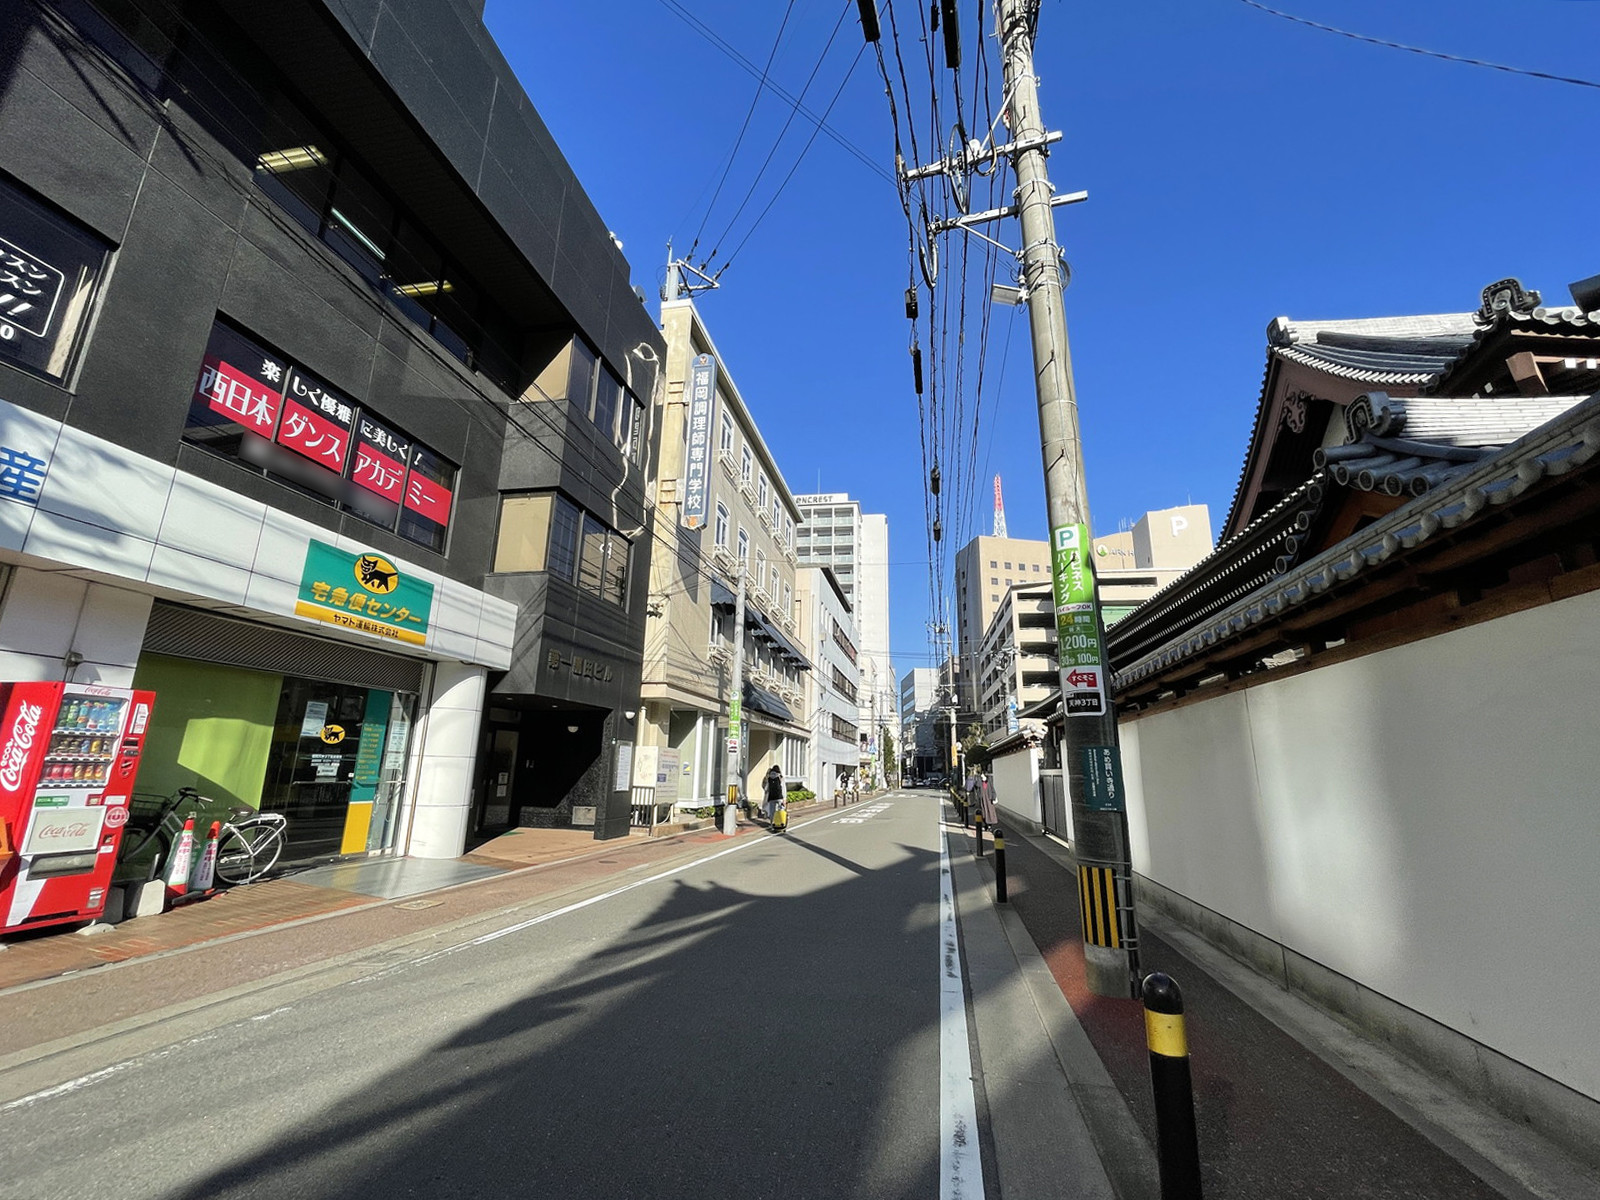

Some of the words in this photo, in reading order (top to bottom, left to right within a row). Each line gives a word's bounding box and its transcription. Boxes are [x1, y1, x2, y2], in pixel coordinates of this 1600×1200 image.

[0, 249, 48, 279] スン
[687, 371, 709, 510] 福岡調理師専門学校
[1059, 531, 1074, 547] P
[1170, 515, 1188, 537] P
[311, 581, 422, 622] 宅急便センター
[334, 614, 399, 638] ヤマト運輸株式会社
[0, 700, 42, 791] Coca-Cola
